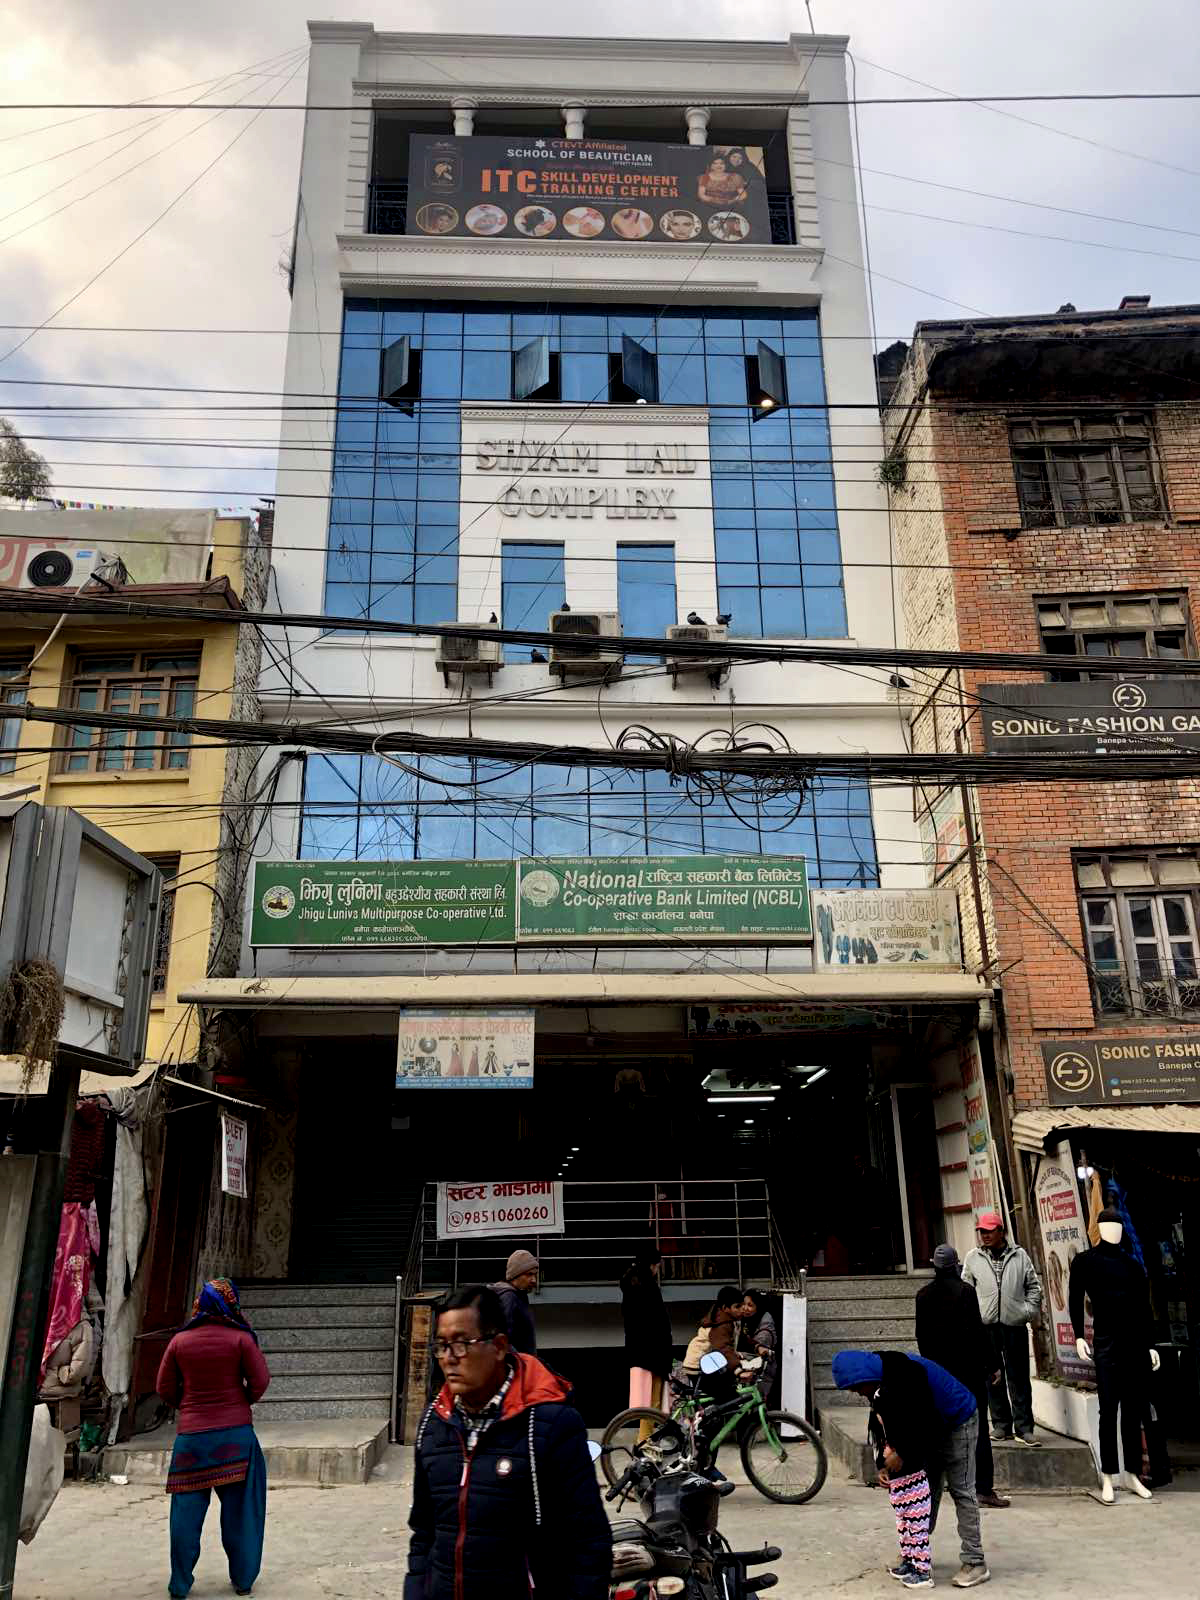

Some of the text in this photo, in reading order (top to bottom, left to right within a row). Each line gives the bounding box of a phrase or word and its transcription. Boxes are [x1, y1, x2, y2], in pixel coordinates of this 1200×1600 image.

[586, 142, 626, 151] Affiliated
[507, 149, 653, 163] SCHOOL OF BEAUTICIAN
[481, 168, 537, 193] ITC
[541, 171, 679, 186] SKILL DEVELOPMENT
[541, 183, 614, 196] TRAINING
[620, 186, 679, 198] CENTER
[476, 440, 697, 474] SHYAM LAL
[497, 485, 677, 520] COMPLEX
[991, 719, 1060, 736] SONIC
[1067, 716, 1165, 734] FASHION
[1097, 737, 1126, 745] Banepa
[563, 869, 643, 889] National
[686, 868, 733, 883] सहकारी
[757, 868, 802, 882] लिमिटेड
[434, 884, 467, 901] सहकारी
[470, 886, 492, 901] संस्था
[562, 889, 803, 909] Co-operative Bank Limited (NCBL)
[298, 907, 325, 922] Jhigu
[361, 907, 423, 922] Multipurpose
[426, 907, 486, 922] Co-operative
[489, 906, 508, 918] Ltd.
[1101, 1045, 1151, 1060] SONIC
[1158, 1062, 1192, 1071] Banepa
[447, 1185, 488, 1202] सटर
[464, 1206, 548, 1225] 9851060260
